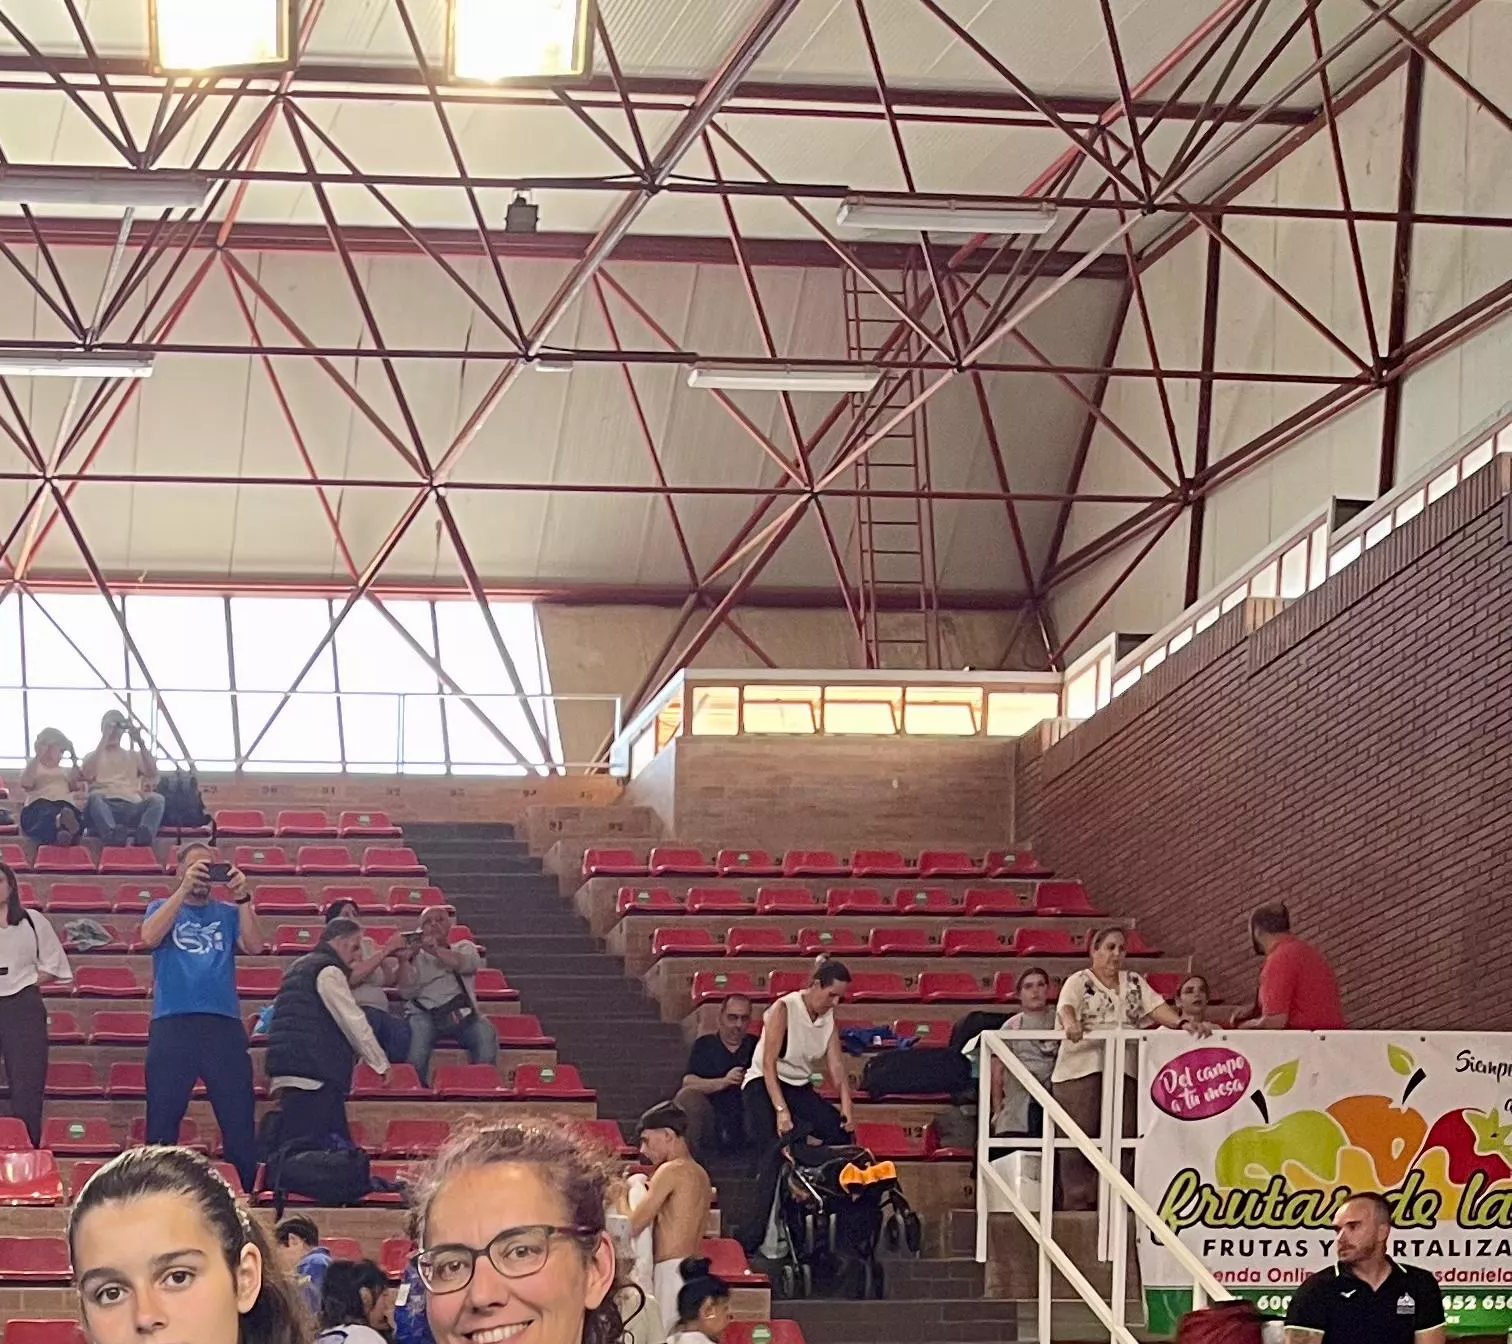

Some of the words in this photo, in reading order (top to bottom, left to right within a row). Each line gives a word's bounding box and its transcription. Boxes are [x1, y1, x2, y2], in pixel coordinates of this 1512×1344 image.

[1159, 1068, 1193, 1095] Del
[1196, 1055, 1245, 1083] campo
[1387, 1168, 1443, 1230] de
[1202, 1238, 1309, 1257] FRUTAS
[1316, 1239, 1335, 1257] Y
[1392, 1238, 1512, 1258] RTALIZA
